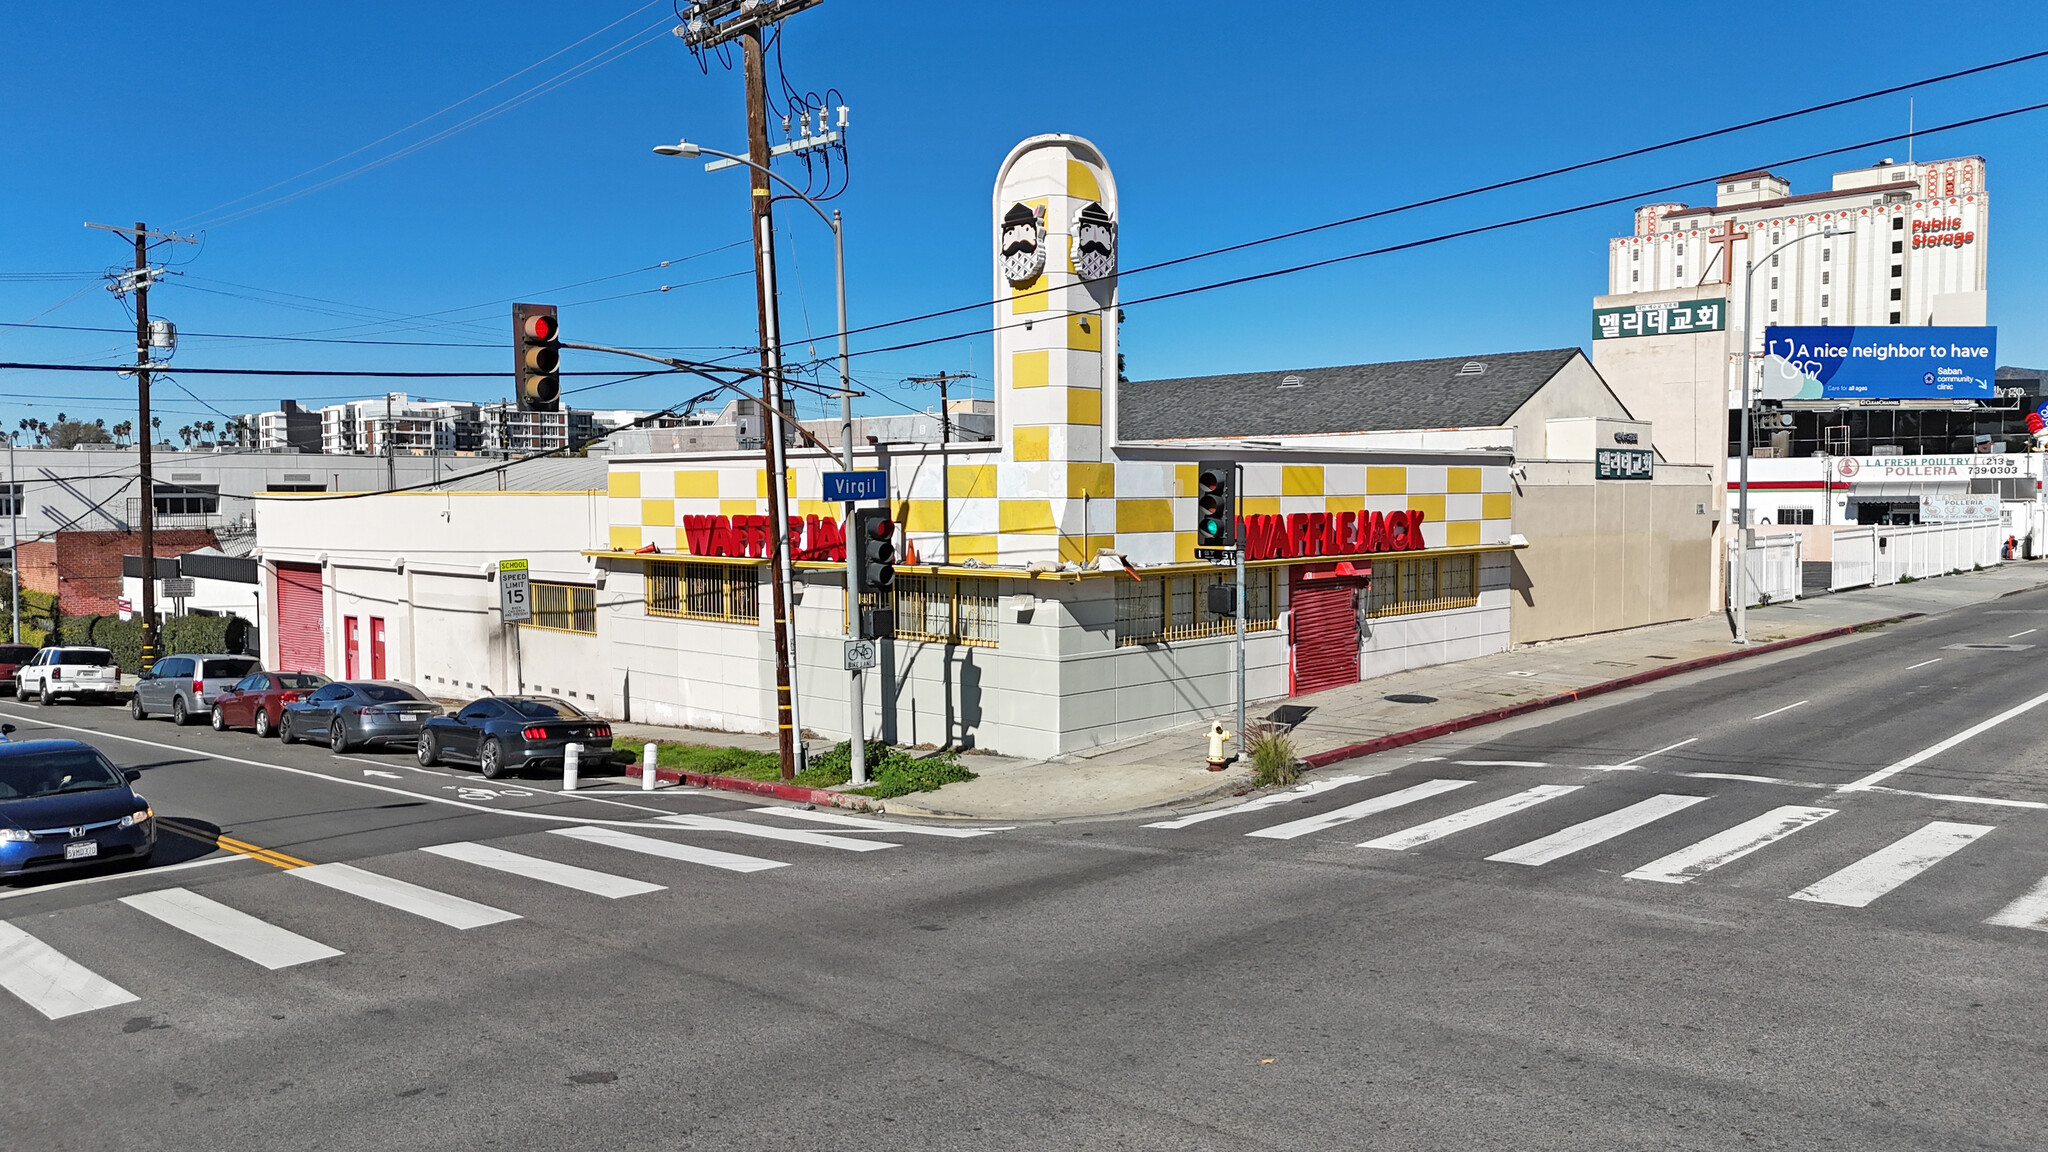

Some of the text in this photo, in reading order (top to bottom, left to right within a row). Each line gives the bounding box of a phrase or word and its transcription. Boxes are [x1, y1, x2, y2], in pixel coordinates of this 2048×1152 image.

[1912, 216, 1962, 231] Public
[1912, 231, 1975, 246] Storage
[1598, 304, 1719, 338] 멜리데교회
[1797, 343, 1989, 361] A nice neighbor to have
[1937, 367, 1963, 375] Saban
[1884, 458, 1917, 467] FRESH
[1921, 457, 1971, 466] POULTRY
[1885, 466, 1958, 476] POLLERIA
[835, 478, 876, 499] Virgil
[505, 581, 524, 589] LIMIT
[507, 589, 525, 604] 15
